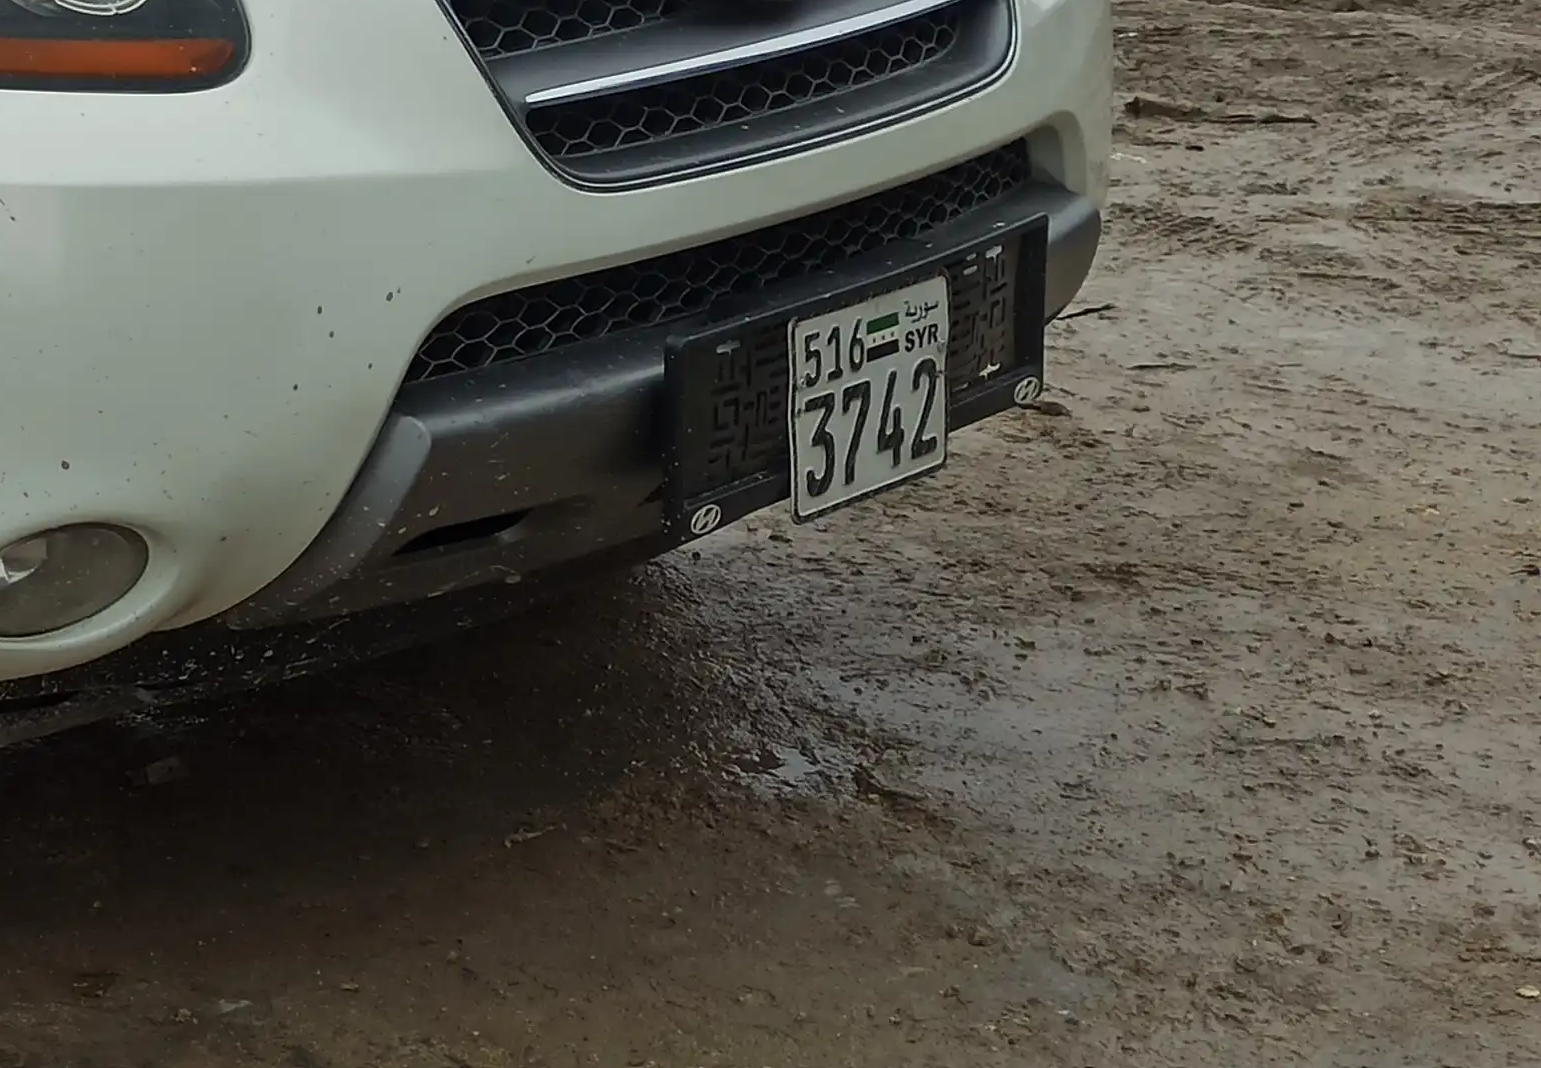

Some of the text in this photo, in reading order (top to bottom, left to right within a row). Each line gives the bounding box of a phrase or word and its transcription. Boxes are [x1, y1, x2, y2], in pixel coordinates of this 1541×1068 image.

[903, 299, 939, 323] سورية
[804, 317, 865, 388] 516
[904, 323, 938, 353] SYR
[804, 358, 938, 498] 3742
